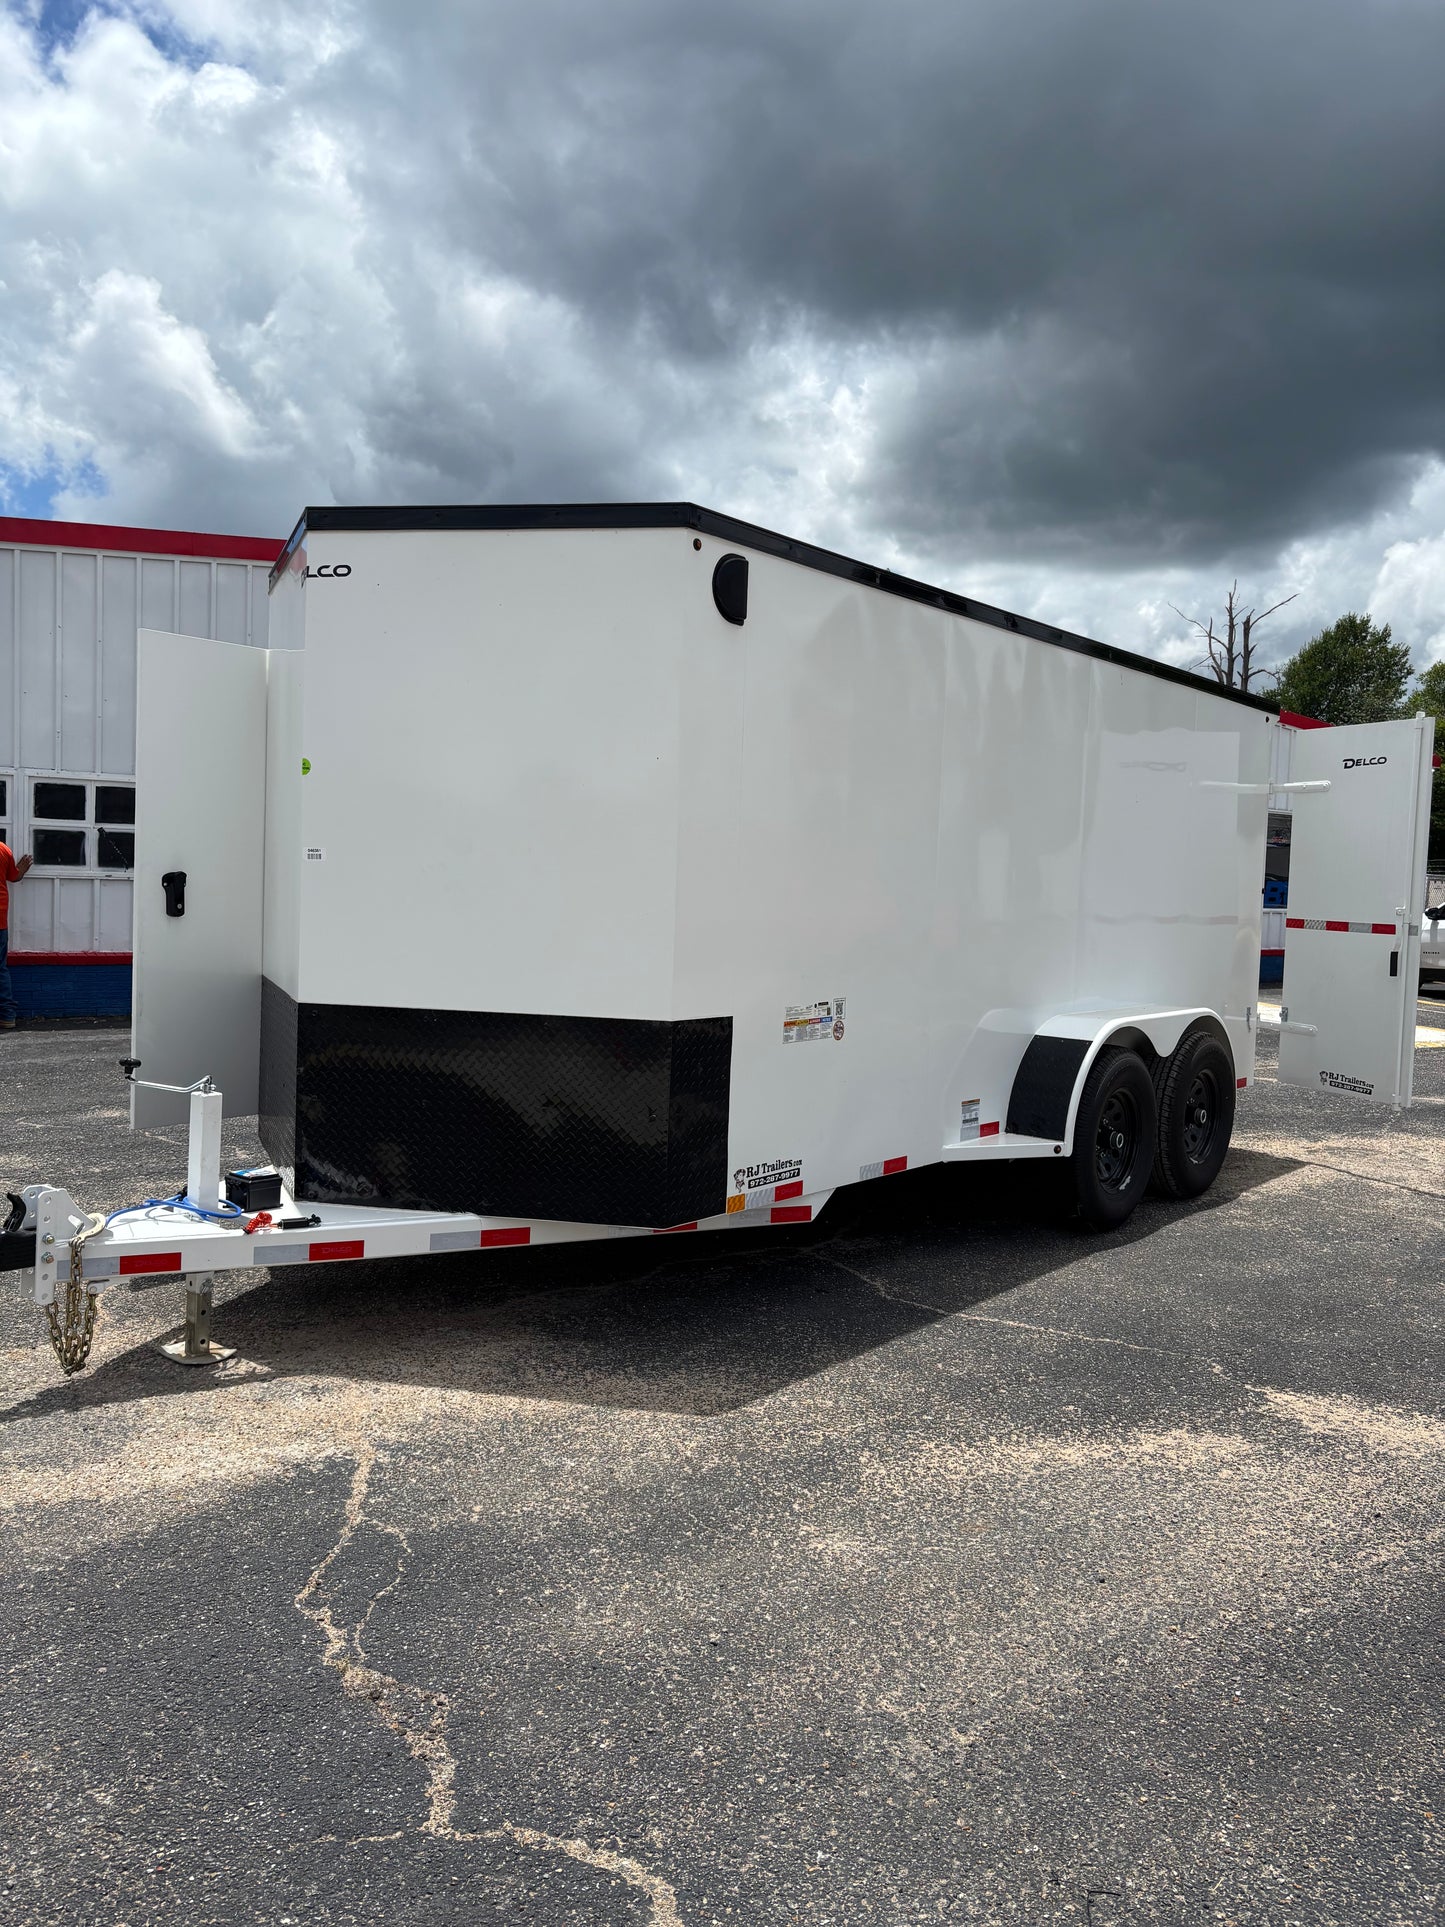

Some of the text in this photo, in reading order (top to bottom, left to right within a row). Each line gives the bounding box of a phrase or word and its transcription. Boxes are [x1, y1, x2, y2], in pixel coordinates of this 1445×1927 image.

[302, 564, 352, 582] LCO
[1342, 756, 1388, 769] DELCO
[1329, 1071, 1339, 1081] RJ
[746, 1164, 760, 1178] RJ
[749, 1169, 799, 1188] 972-287-9977
